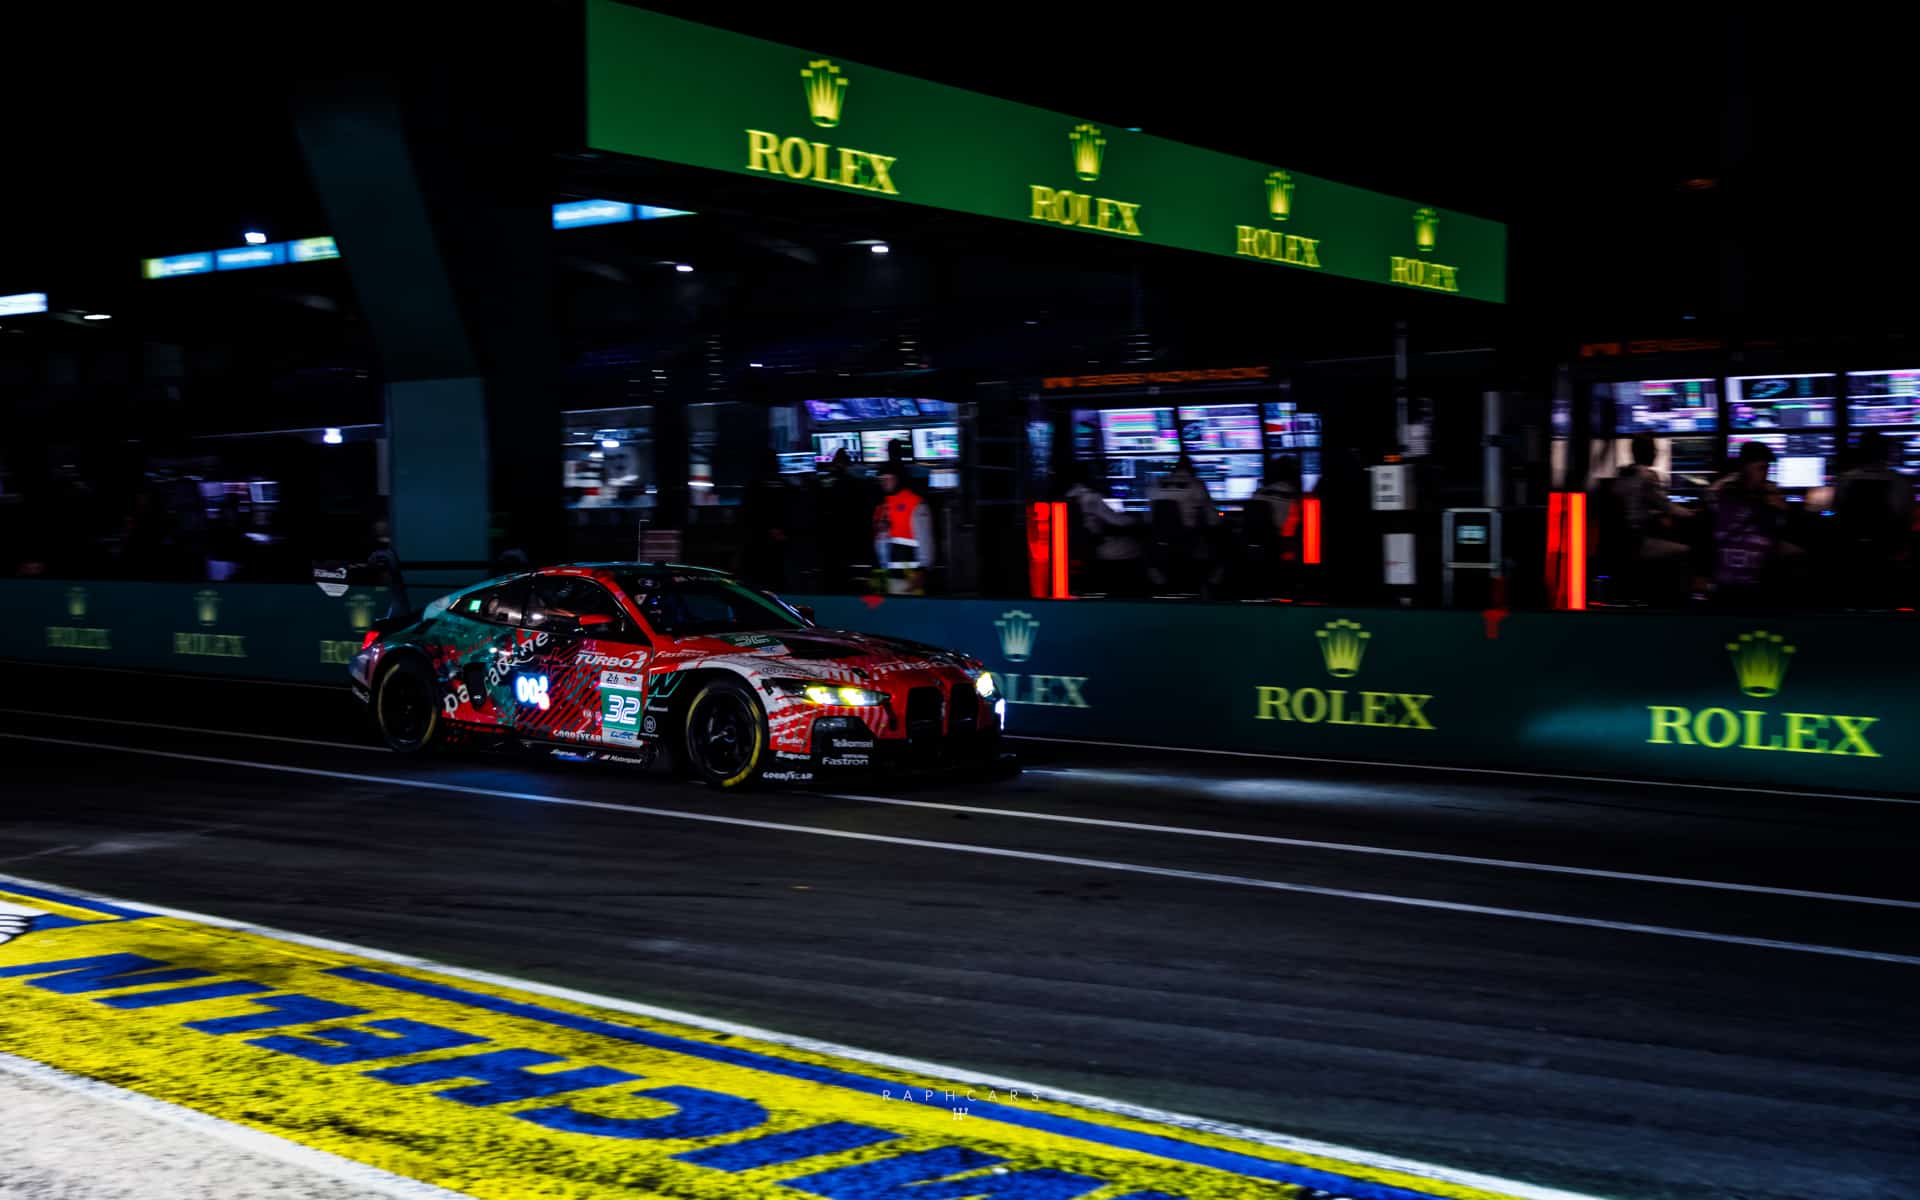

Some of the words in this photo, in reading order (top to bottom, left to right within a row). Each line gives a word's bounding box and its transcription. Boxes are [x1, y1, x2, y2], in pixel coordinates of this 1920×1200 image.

[745, 129, 899, 195] ROLEX
[1029, 184, 1143, 236] ROLEX
[1235, 225, 1321, 268] ROLEX
[1390, 256, 1459, 292] ROLEX
[574, 653, 633, 668] TURBO
[991, 672, 1092, 708] LEX
[1254, 686, 1437, 730] ROLEX
[604, 695, 640, 725] 32
[1646, 705, 1883, 758] ROLEX
[761, 770, 814, 781] GOODYEAR
[821, 755, 869, 766] Fastron
